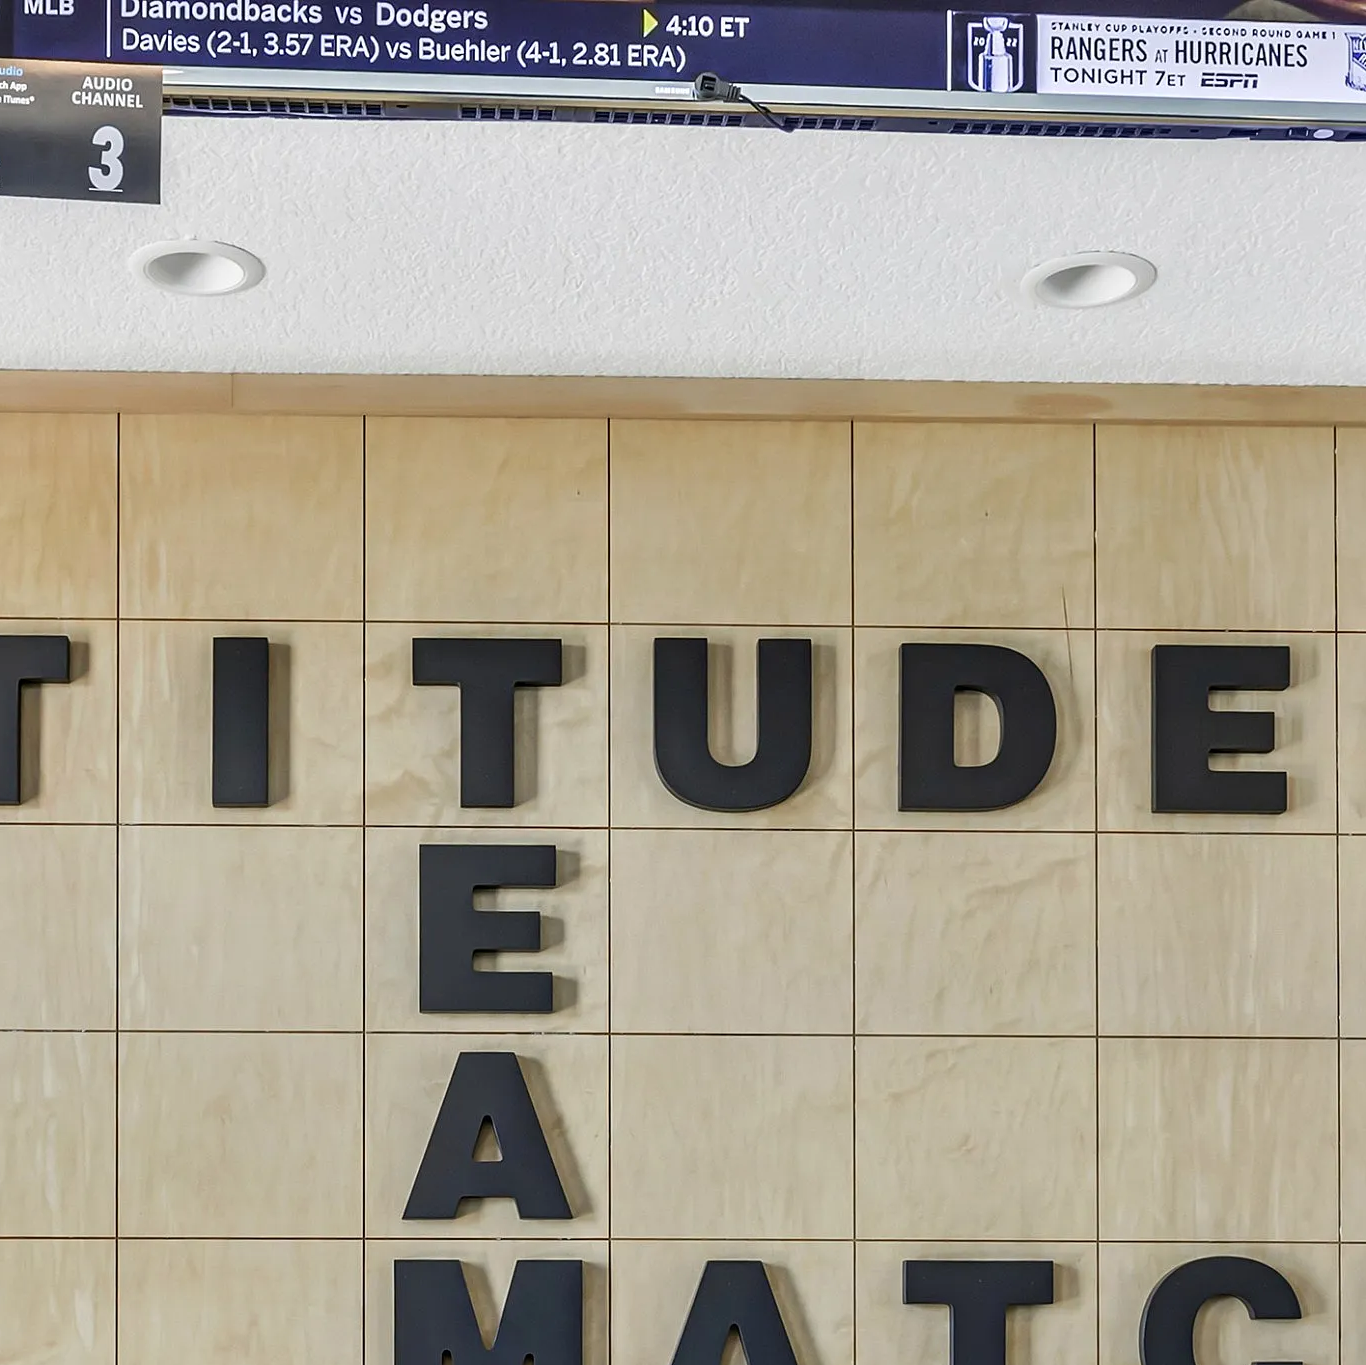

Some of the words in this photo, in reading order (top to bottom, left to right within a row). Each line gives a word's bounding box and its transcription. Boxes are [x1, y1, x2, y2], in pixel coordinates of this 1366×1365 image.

[23, 0, 74, 15] MLB
[120, 0, 323, 24] Diamondbacks
[335, 6, 363, 25] vs
[376, 2, 488, 32] Dodgers
[665, 15, 714, 37] 4:10
[720, 16, 750, 38] ET
[1051, 21, 1101, 32] STANLEY
[1105, 23, 1127, 33] CUP
[1132, 24, 1189, 35] PLAYOFFS
[1202, 26, 1247, 37] SECOND
[1252, 28, 1291, 38] ROUND
[1296, 30, 1327, 39] GAME
[122, 28, 201, 52] Davies
[206, 30, 258, 58] (2-1,
[263, 33, 314, 56] 3.57
[320, 35, 380, 63] ERA)
[385, 41, 413, 59] vs
[418, 38, 511, 62] Buehler
[516, 40, 566, 68] (4-1,
[572, 43, 621, 66] 2.81
[627, 45, 686, 72] ERA)
[1050, 36, 1148, 63] RANGERS
[1154, 49, 1168, 64] AT
[1175, 40, 1308, 68] HURRICANES
[10, 81, 28, 92] App
[82, 76, 133, 92] AUDIO
[1050, 67, 1147, 86] TONIGHT
[1155, 71, 1186, 87] 7ET
[1201, 72, 1258, 89] ESPN
[71, 91, 144, 108] CHANNEL
[88, 125, 124, 190] 3
